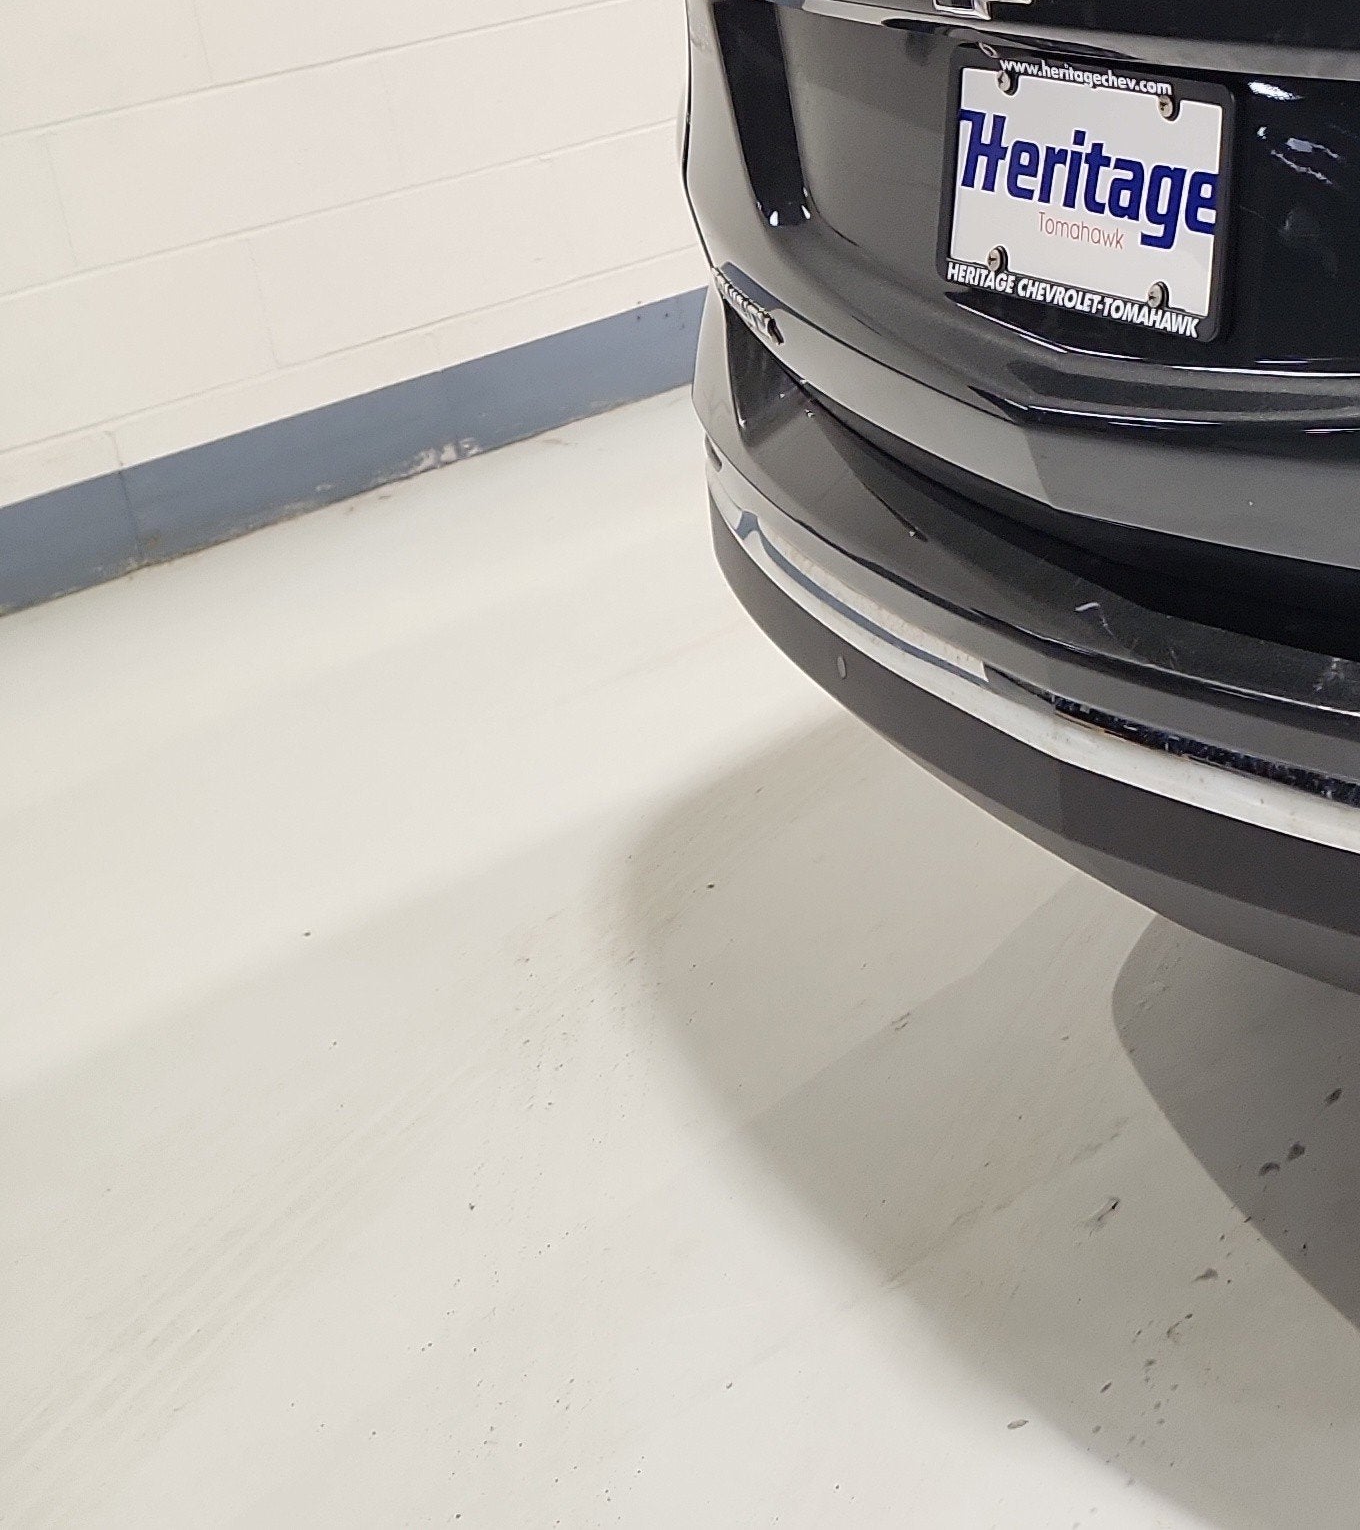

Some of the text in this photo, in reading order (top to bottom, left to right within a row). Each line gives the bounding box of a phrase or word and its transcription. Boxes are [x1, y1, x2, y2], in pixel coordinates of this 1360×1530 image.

[1001, 58, 1173, 95] www.heritagechev.com
[959, 108, 1220, 250] Heritage
[1038, 211, 1124, 250] Tomahawk
[947, 261, 1200, 339] HERITAGE CHEVROLET-TOMAHAWK
